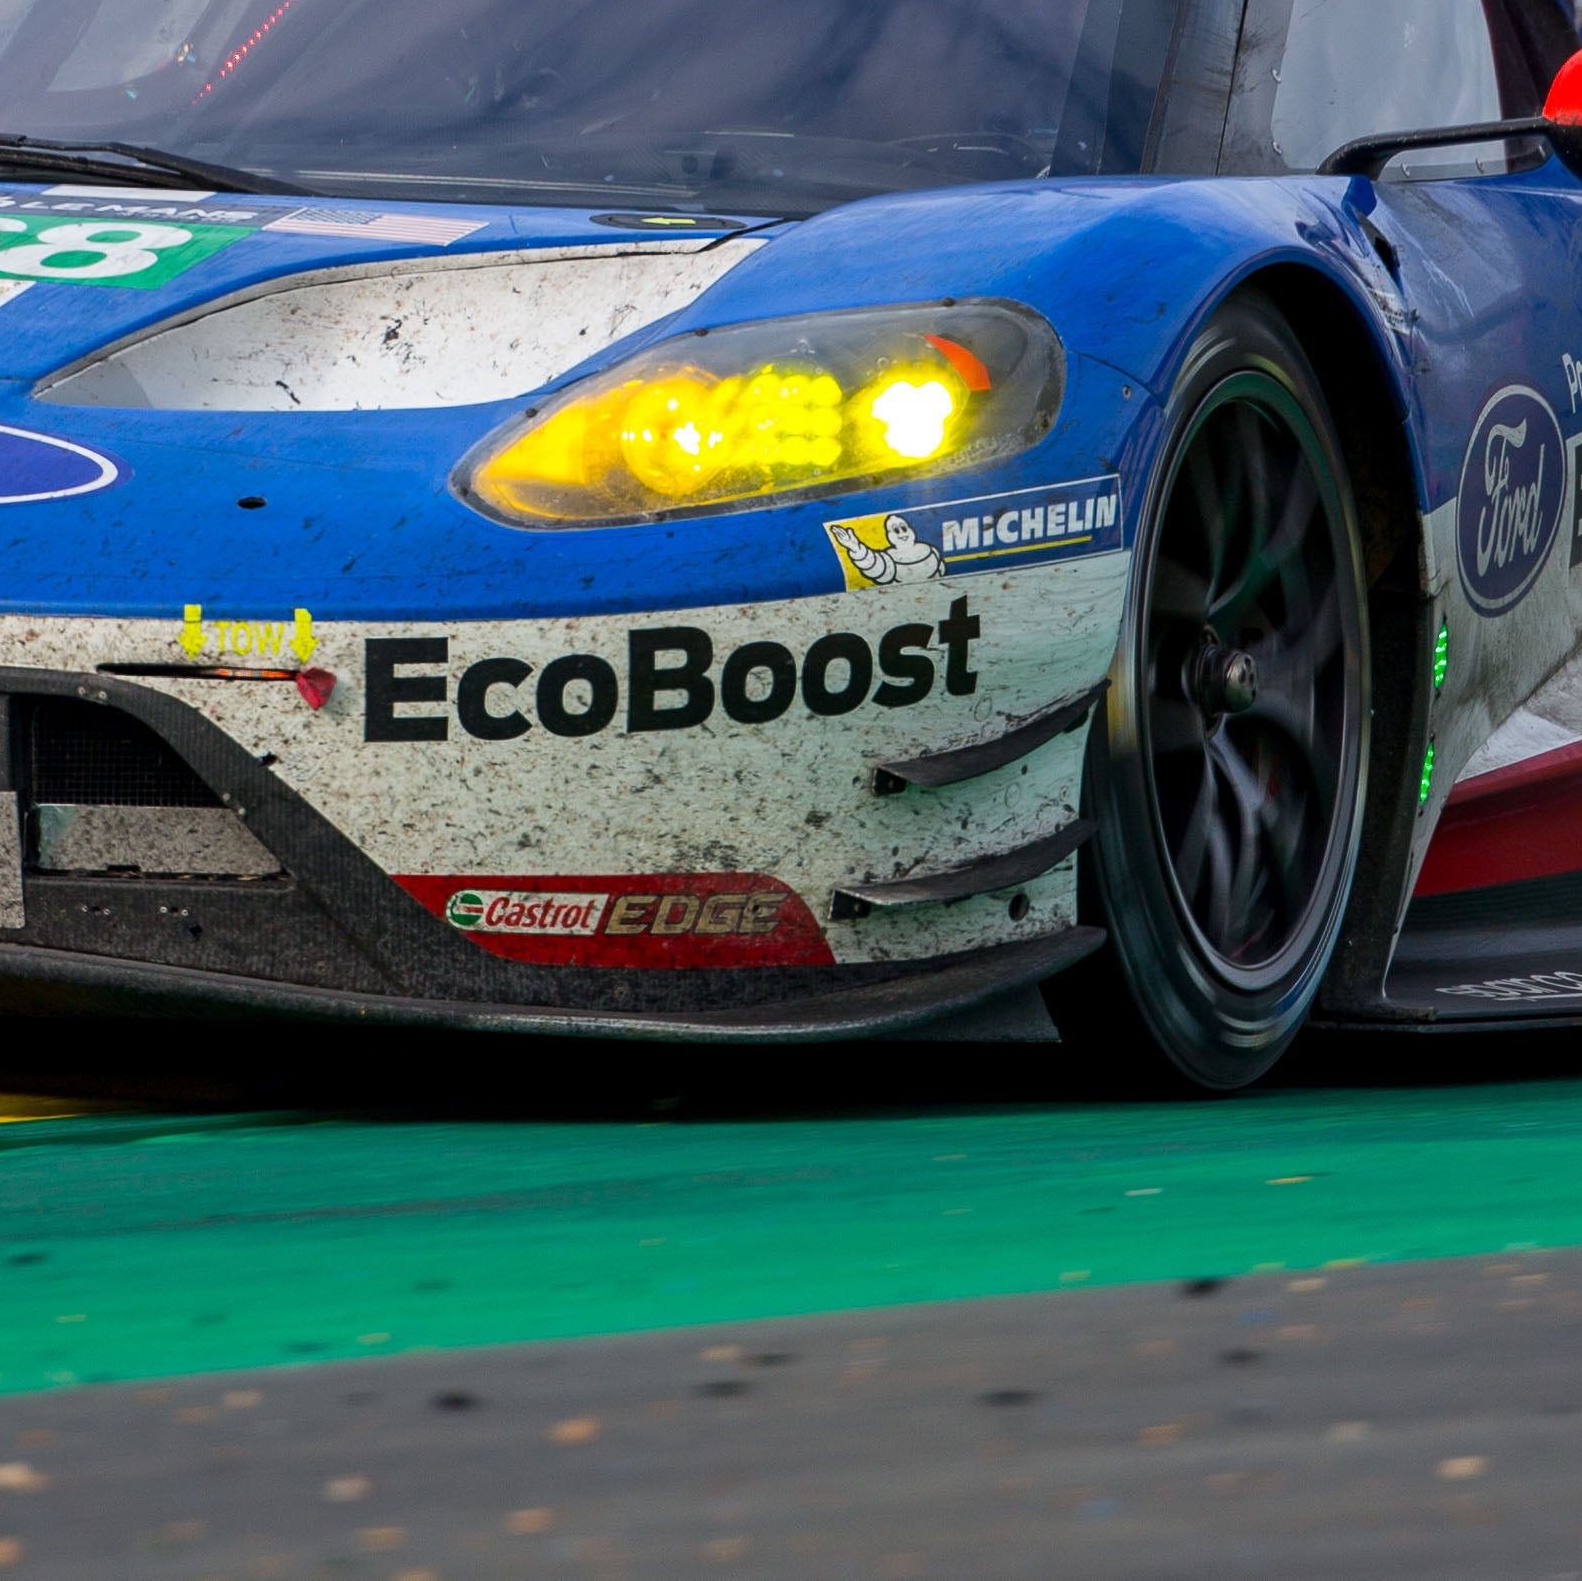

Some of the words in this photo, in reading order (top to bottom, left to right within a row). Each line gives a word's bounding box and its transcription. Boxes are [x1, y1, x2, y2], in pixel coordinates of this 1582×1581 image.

[942, 494, 1118, 552] MICHELIN
[1476, 417, 1546, 578] Ford
[213, 621, 285, 657] TOW
[364, 595, 981, 743] EcoBoost
[484, 894, 595, 929] Castrol
[604, 891, 789, 935] EDGE
